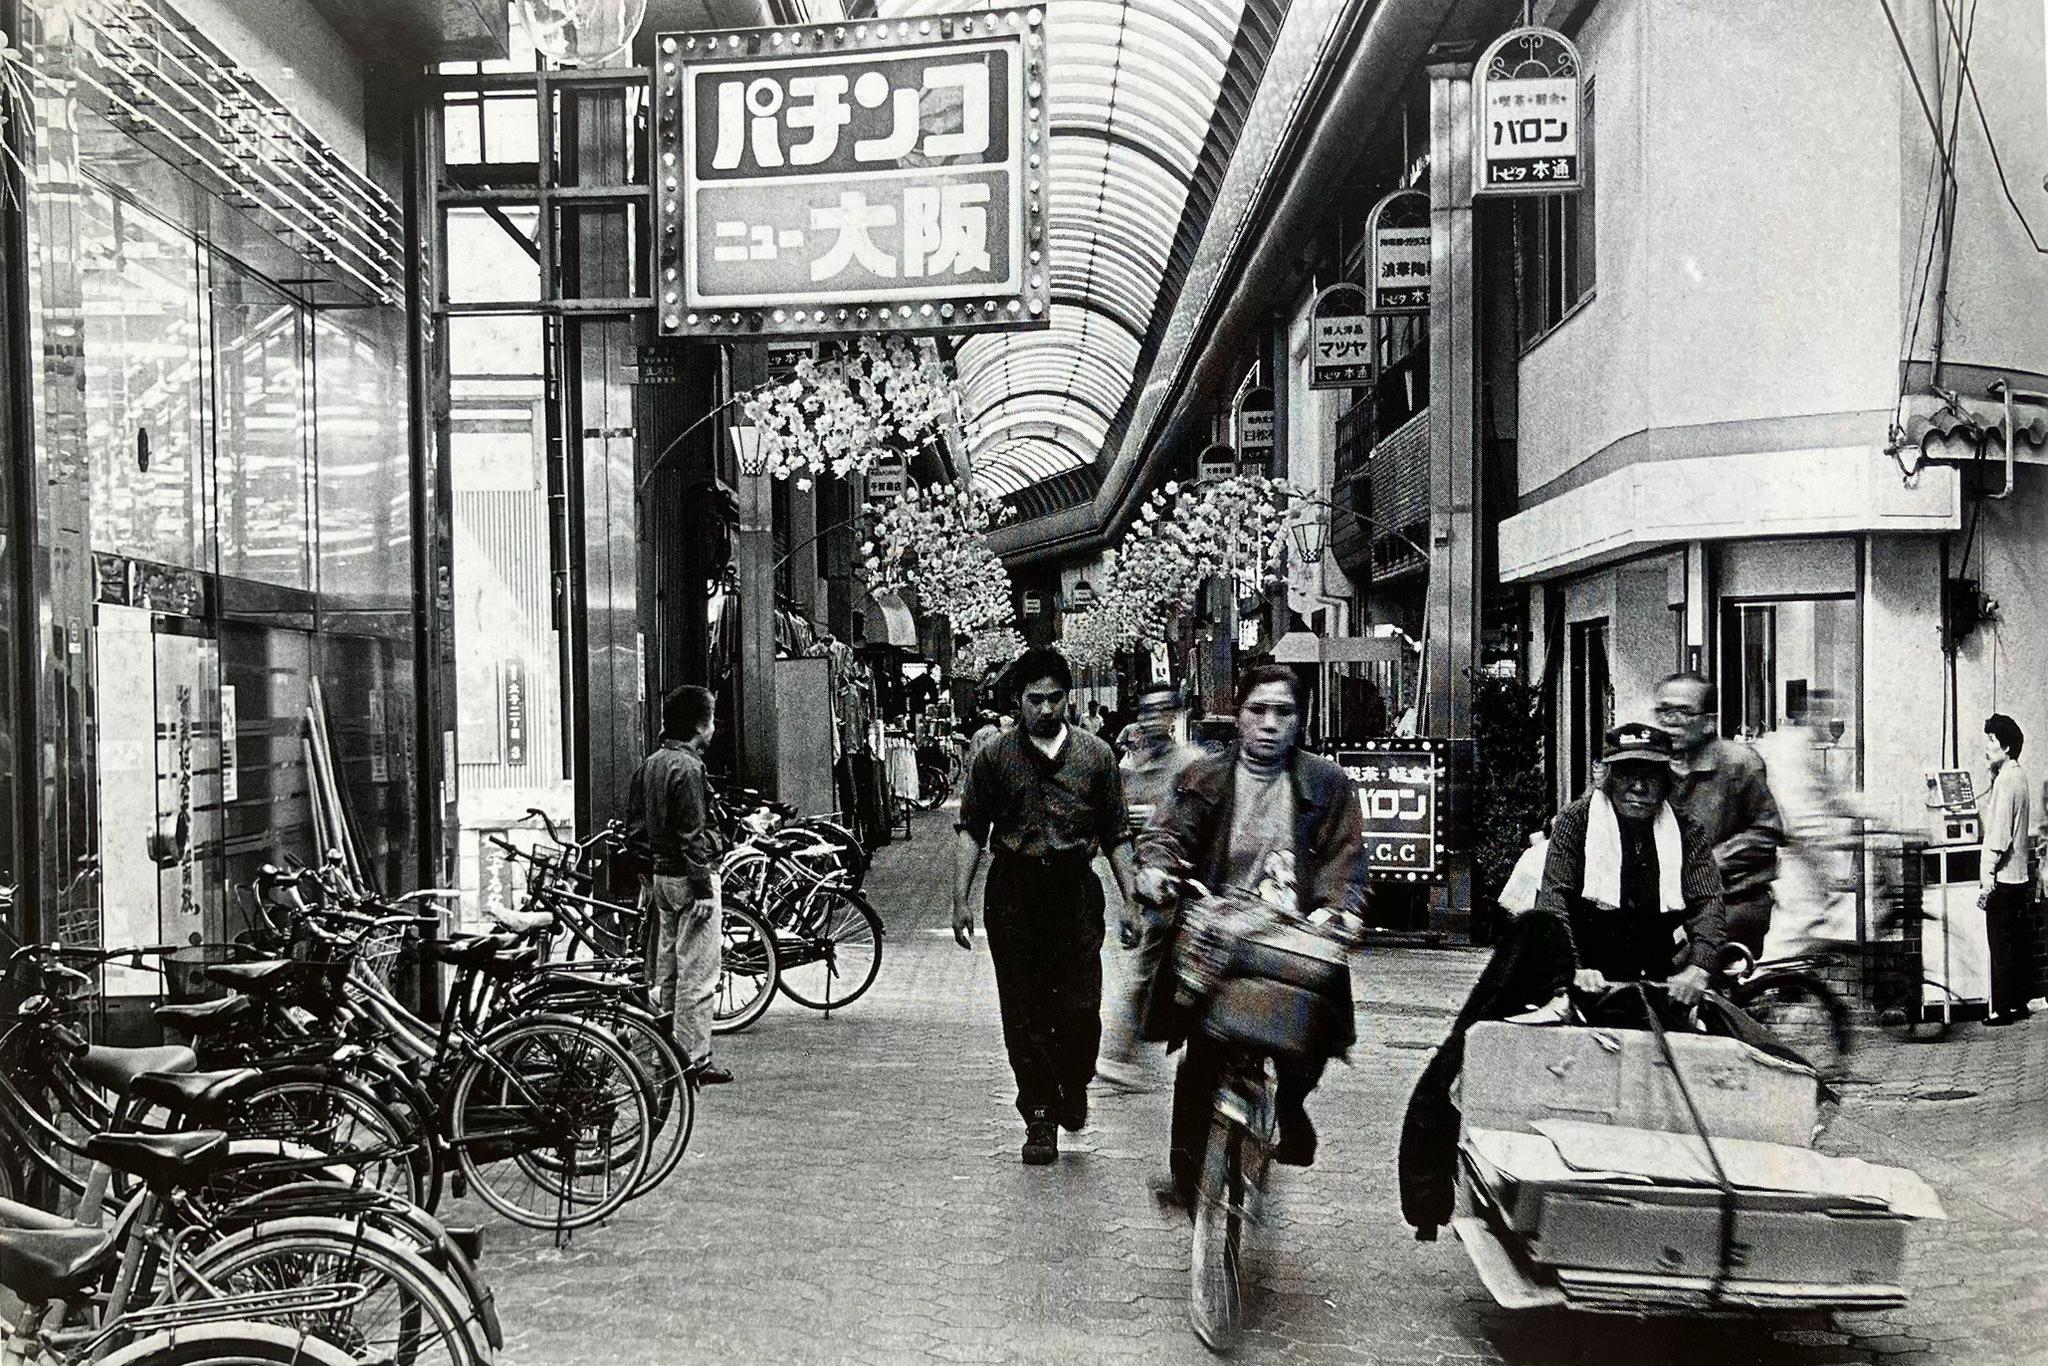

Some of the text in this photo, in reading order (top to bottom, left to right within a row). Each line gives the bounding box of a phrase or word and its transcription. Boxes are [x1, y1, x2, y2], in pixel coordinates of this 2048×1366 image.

[712, 62, 990, 169] パチンコ
[1493, 118, 1567, 146] バロン
[713, 183, 991, 281] ニュー大阪
[1319, 340, 1367, 358] マツヤ
